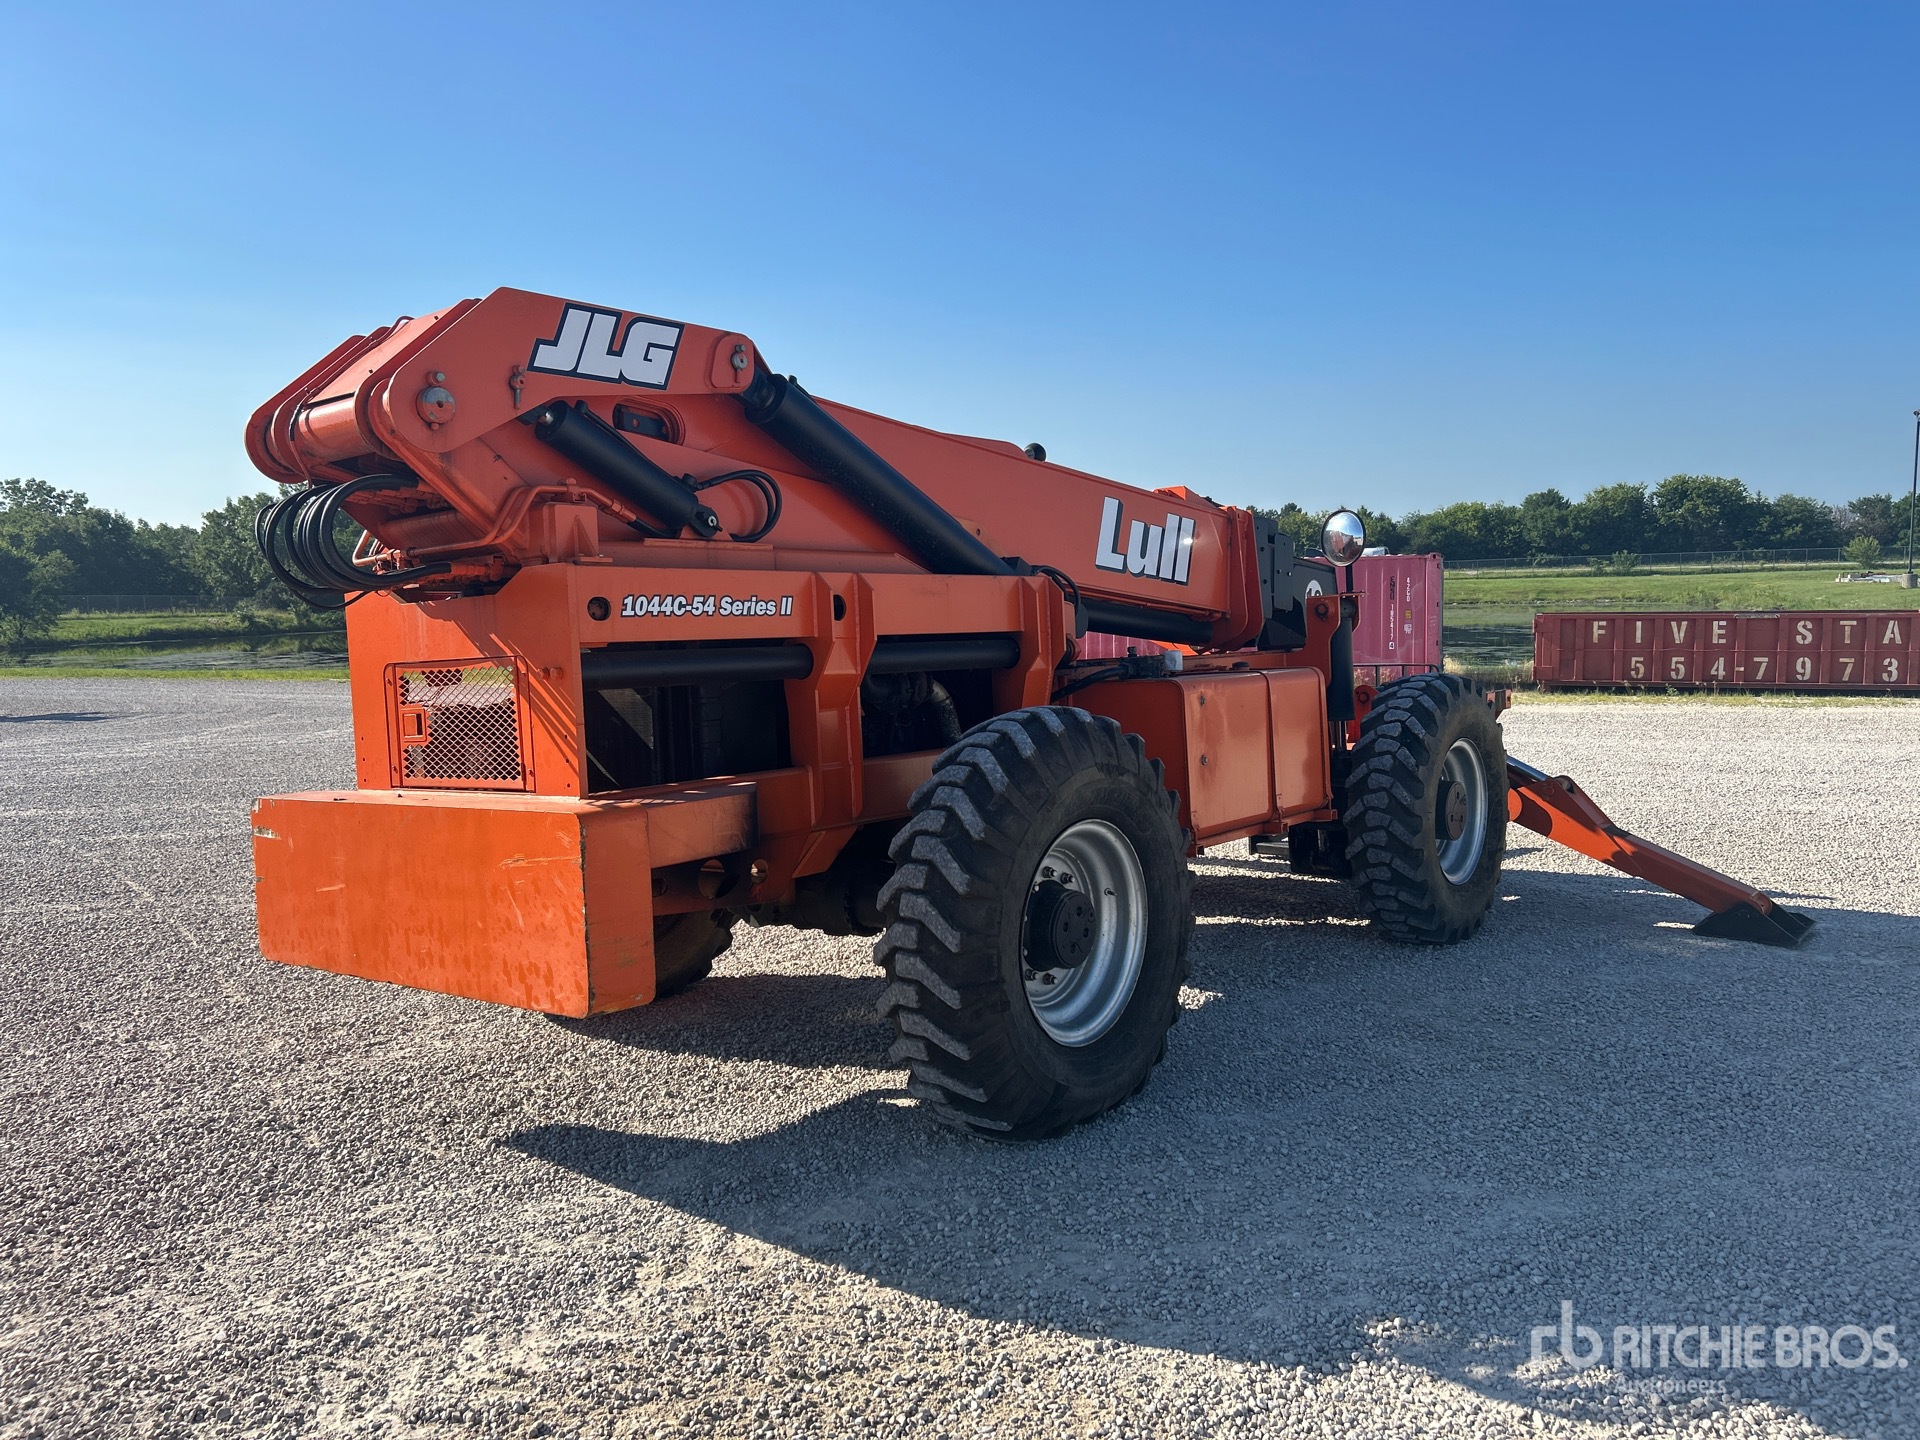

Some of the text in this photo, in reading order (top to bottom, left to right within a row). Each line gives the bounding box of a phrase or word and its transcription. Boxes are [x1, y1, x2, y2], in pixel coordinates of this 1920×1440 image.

[529, 304, 684, 389] JLG
[1095, 496, 1195, 586] Lull
[621, 595, 716, 617] 1044C-54
[718, 596, 777, 617] Series
[1592, 620, 1902, 645] FIVE STA
[1630, 657, 1899, 682] 554-7973
